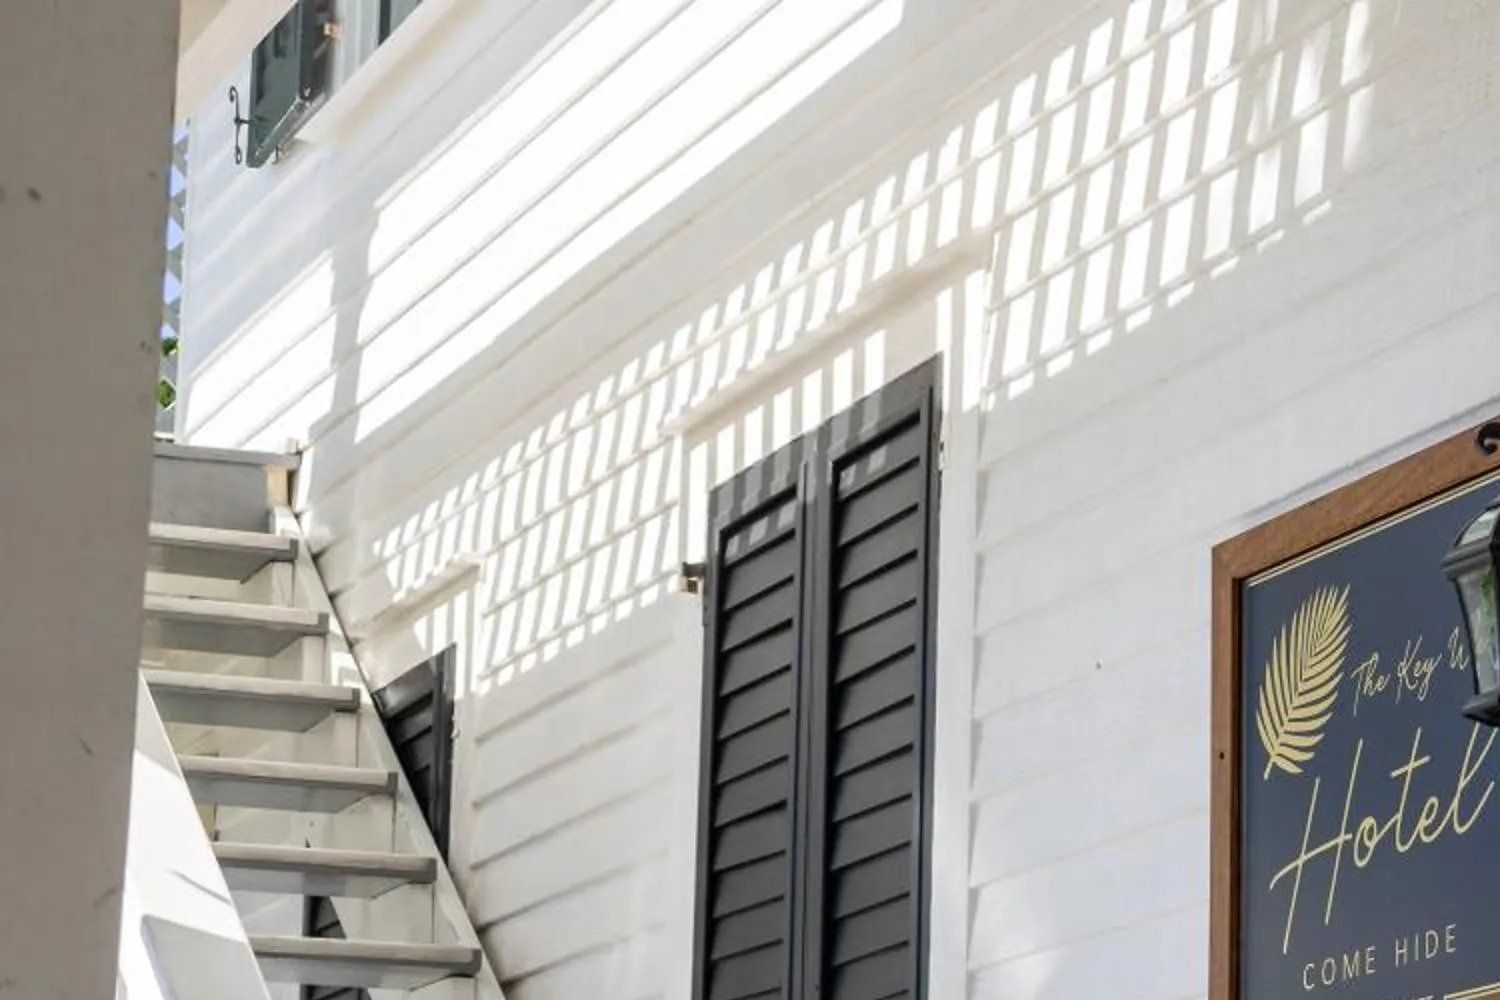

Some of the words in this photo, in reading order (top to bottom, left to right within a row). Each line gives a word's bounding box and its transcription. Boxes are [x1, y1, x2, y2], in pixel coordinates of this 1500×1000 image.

[1350, 650, 1391, 718] The
[1395, 634, 1443, 702] Key
[1269, 722, 1500, 956] Hotel
[1302, 945, 1379, 990] COME
[1394, 923, 1459, 968] HIDE
